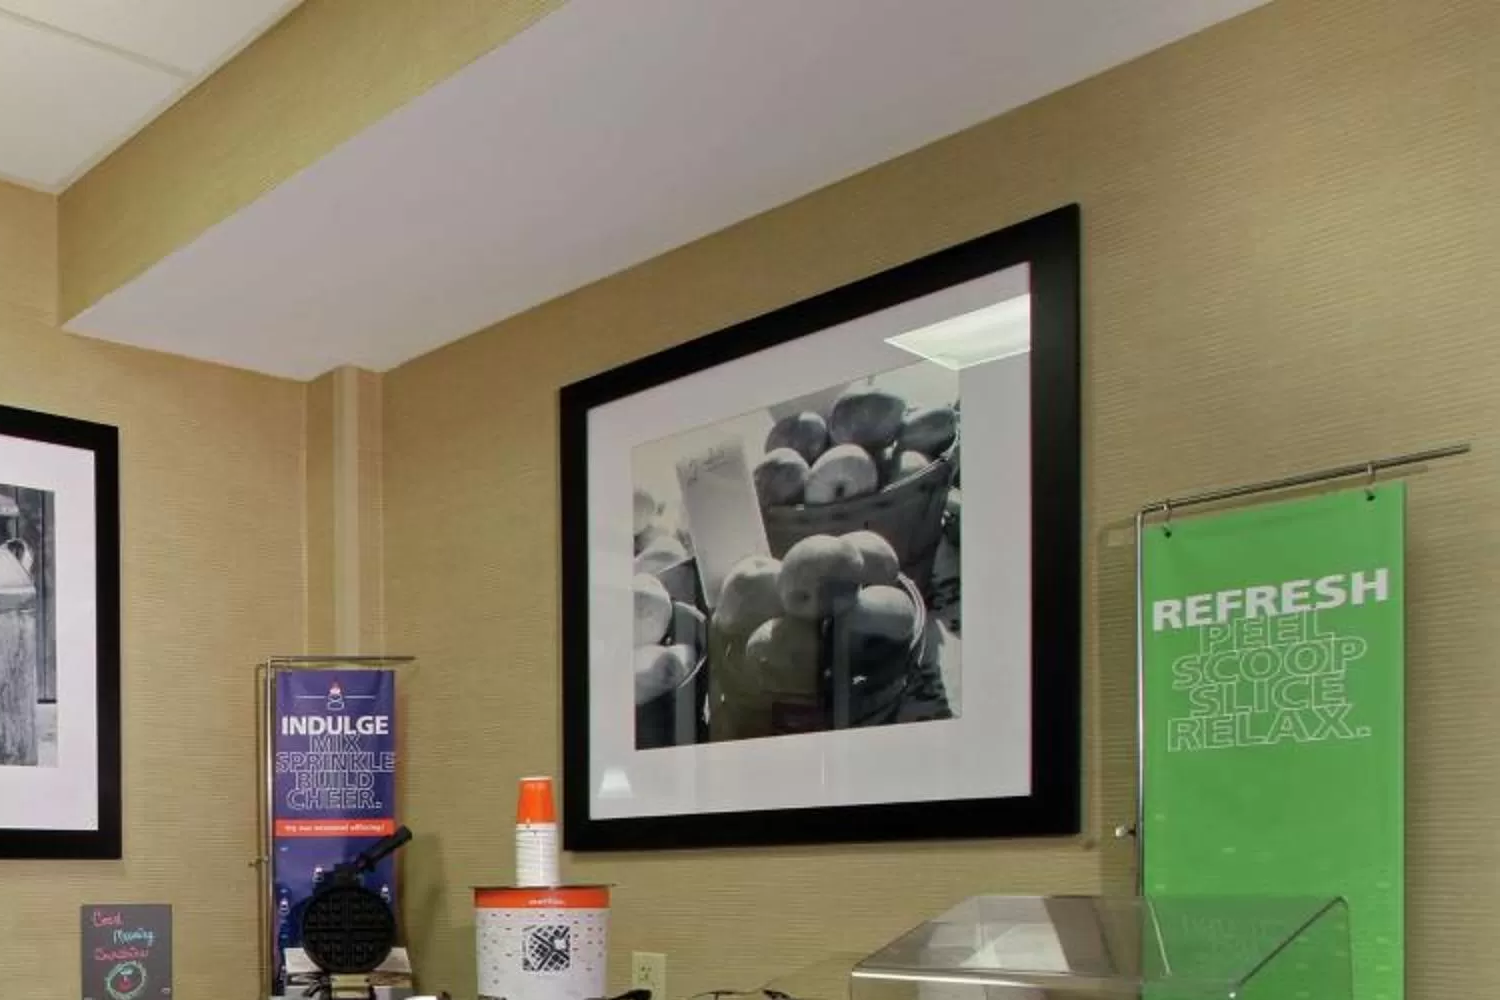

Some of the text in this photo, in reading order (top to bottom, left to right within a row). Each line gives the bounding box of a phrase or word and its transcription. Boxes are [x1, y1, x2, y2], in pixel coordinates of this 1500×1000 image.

[1153, 568, 1389, 631] REFRESH
[1200, 607, 1334, 654] PEEL
[1172, 636, 1367, 690] SCOOP
[1189, 671, 1351, 718] SLICE
[281, 715, 389, 736] INDULGE
[309, 733, 361, 753] MIX
[1167, 704, 1371, 752] RELAX.
[275, 752, 396, 773] SPRINKLE
[286, 787, 383, 809] CHEER.
